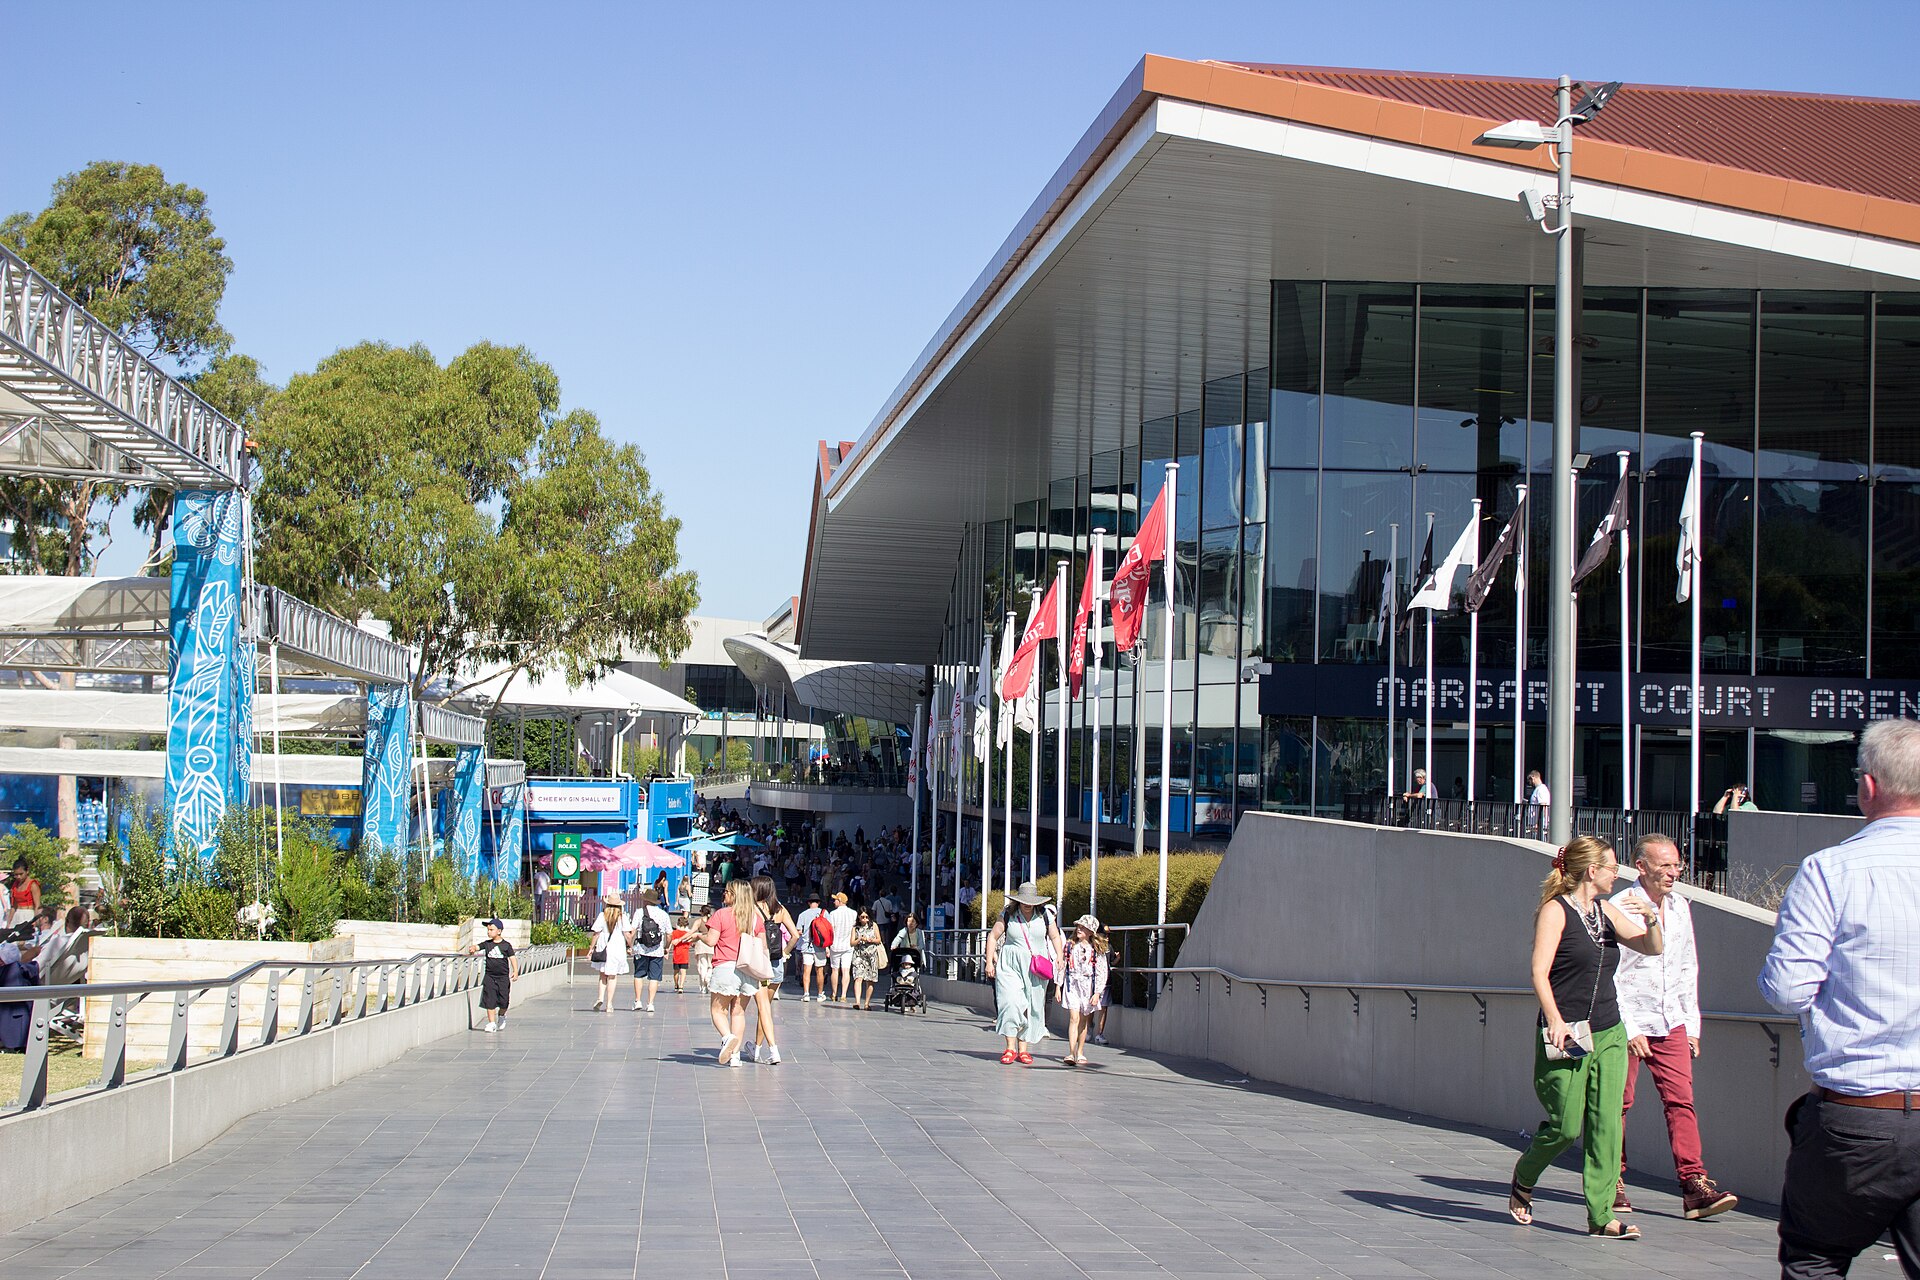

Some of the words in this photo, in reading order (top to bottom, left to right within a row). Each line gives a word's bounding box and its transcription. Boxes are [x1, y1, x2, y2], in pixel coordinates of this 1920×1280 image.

[1377, 677, 1604, 712] MARGART
[1640, 684, 1775, 717] COURT
[311, 792, 360, 800] CHUBB
